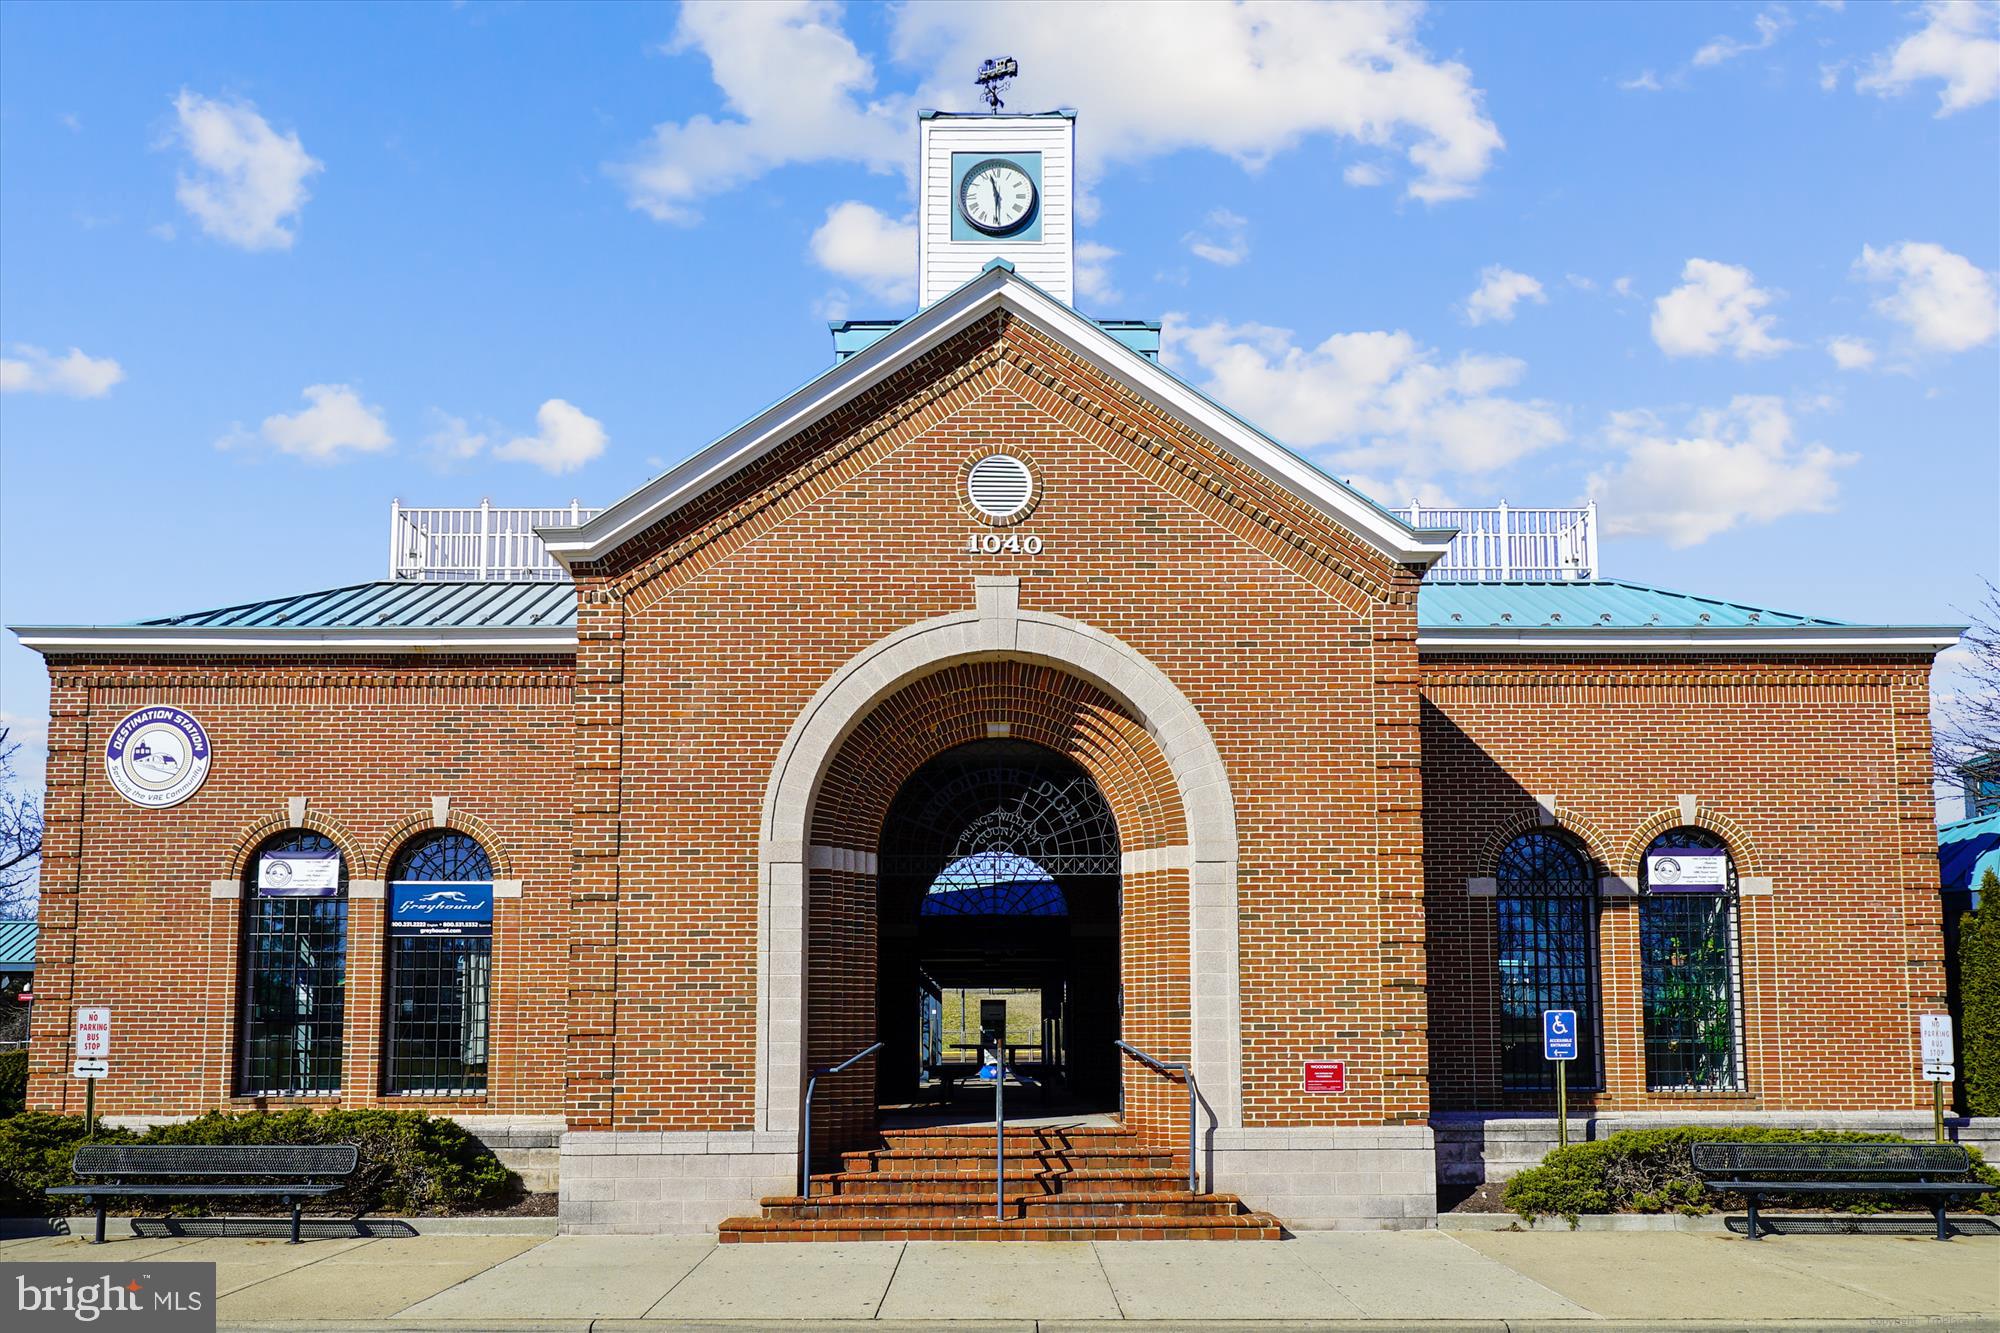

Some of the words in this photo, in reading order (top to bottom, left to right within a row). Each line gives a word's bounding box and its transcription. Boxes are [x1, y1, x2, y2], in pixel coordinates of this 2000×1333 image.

[968, 534, 1043, 555] 1040
[113, 710, 174, 750] DESTINATION
[173, 715, 204, 751] STATION
[111, 765, 132, 793] Serving
[132, 790, 146, 800] the
[165, 766, 203, 800] Community
[959, 814, 994, 842] PRINCE
[998, 812, 1041, 843] WILLIAM
[977, 827, 1024, 845] COUNTY
[397, 900, 486, 913] Greyhound
[79, 1023, 108, 1031] PARKING
[84, 1042, 101, 1050] STOP
[86, 1033, 100, 1041] BUS
